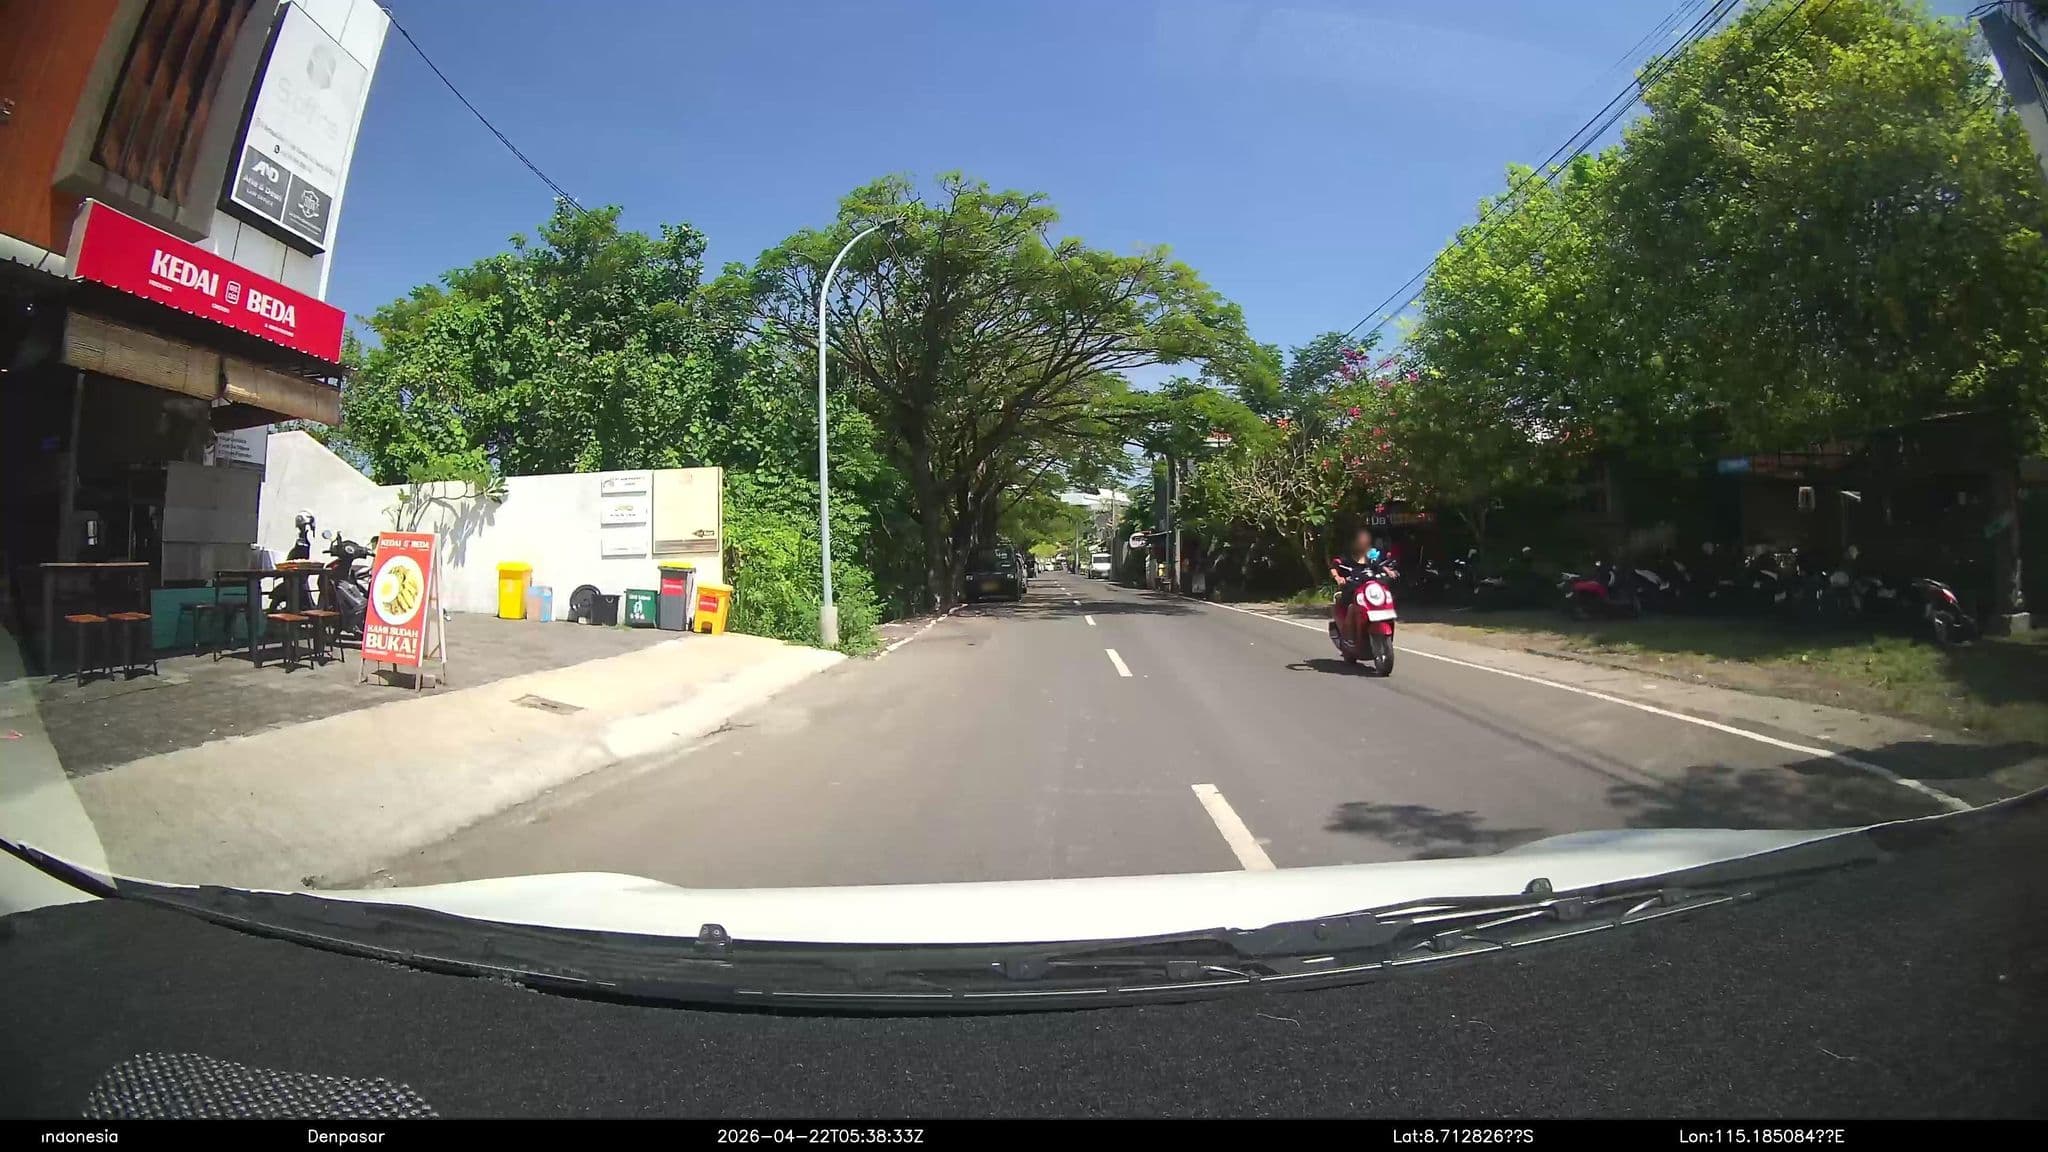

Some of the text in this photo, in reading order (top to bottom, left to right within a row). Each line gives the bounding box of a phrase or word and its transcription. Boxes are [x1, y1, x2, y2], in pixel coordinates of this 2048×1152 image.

[151, 249, 219, 297] KEDAI
[247, 289, 295, 327] BEDA
[368, 624, 418, 638] KAMI SUDAH
[365, 633, 418, 655] BUKA!
